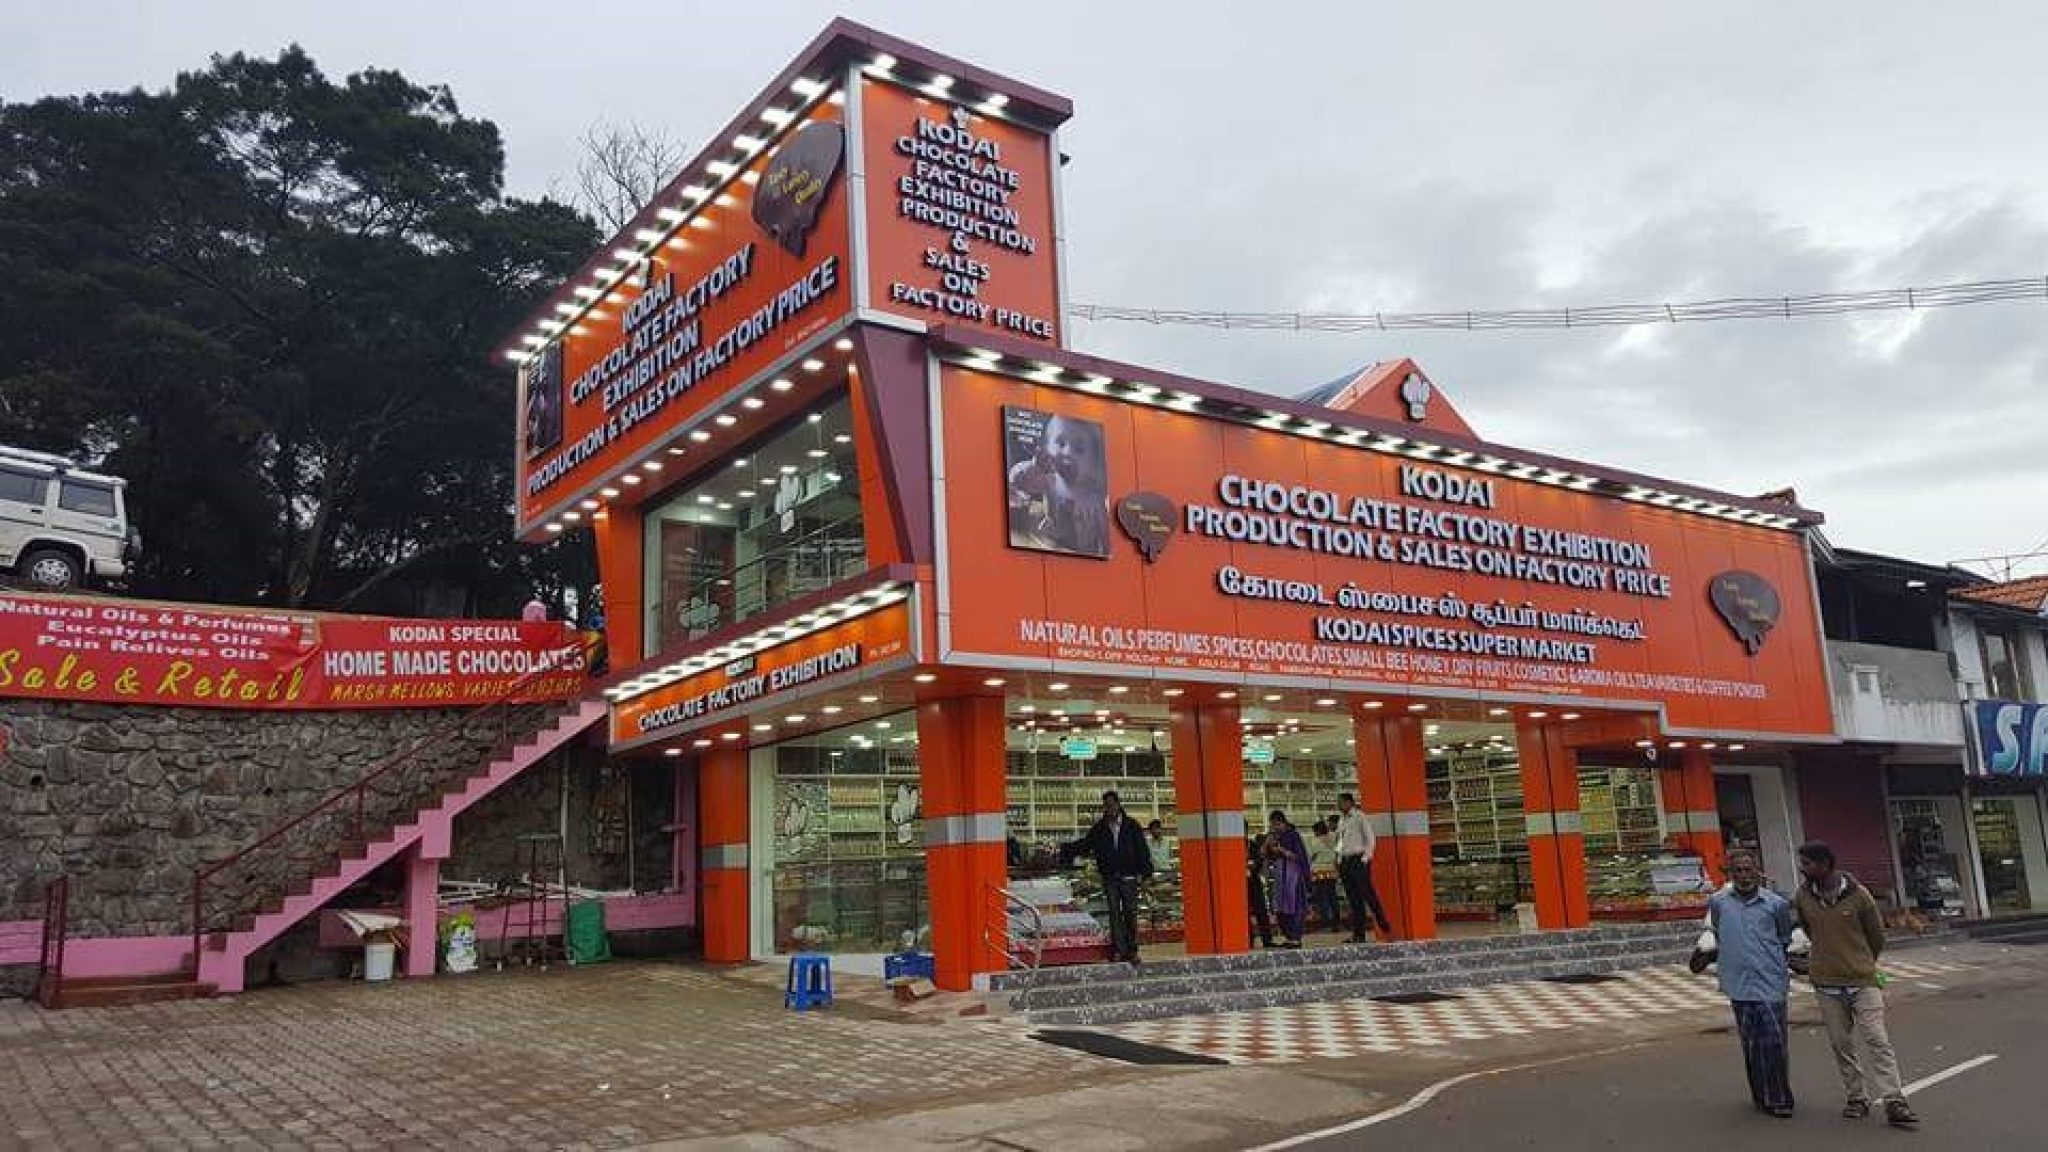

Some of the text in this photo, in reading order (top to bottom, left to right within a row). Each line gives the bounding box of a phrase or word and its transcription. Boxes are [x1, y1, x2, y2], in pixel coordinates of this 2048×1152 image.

[898, 136, 1018, 188] CHOCOLATE
[917, 117, 999, 160] KODAI
[900, 176, 1018, 224] EXHIBITION
[916, 161, 1009, 204] FACTORY
[901, 198, 1035, 253] PRODUCTION
[951, 231, 970, 252] &
[926, 247, 990, 280] SALES
[943, 271, 978, 296] ON
[569, 243, 754, 404] CHOCOLATE FACTORY
[622, 272, 672, 333] KODAI
[893, 283, 1053, 337] FACTORY PRICE
[528, 423, 605, 496] PRODUCTION
[621, 380, 665, 432] SALES
[666, 360, 693, 397] ON
[694, 300, 775, 380] FACTORY
[777, 255, 838, 322] PRICE
[603, 319, 698, 413] EXHIBITION
[1402, 464, 1495, 508] KODAI
[1220, 475, 1402, 531] CHOCOLATE
[1405, 506, 1519, 548] FACTORY
[1523, 525, 1652, 569] EXHIBITION
[1186, 504, 1373, 560] PRODUCTION
[1377, 533, 1396, 560] &
[1400, 537, 1474, 571] SALES
[1476, 548, 1513, 575] ON
[1515, 554, 1608, 591] FACTORY
[1615, 568, 1672, 598] PRICE
[0, 599, 291, 635] Natural Oils & Perfumes
[48, 620, 264, 646] Eucalyptus Oils
[389, 626, 522, 643] KODAI SPECIAL
[1317, 616, 1597, 664] KODAI SPICES SUPER MARKET
[37, 634, 270, 661] Pain Relives Oils
[323, 643, 586, 677] HOME MADE CHOCOLATES
[1020, 618, 1100, 647] NATURAL
[1343, 646, 1384, 669] SMALL
[1386, 652, 1409, 671] BEE
[0, 647, 305, 701] Sale & Retail
[638, 697, 705, 733] CHOCOLATE
[707, 674, 765, 711] FACTORY
[771, 643, 860, 691] EXHIBITION
